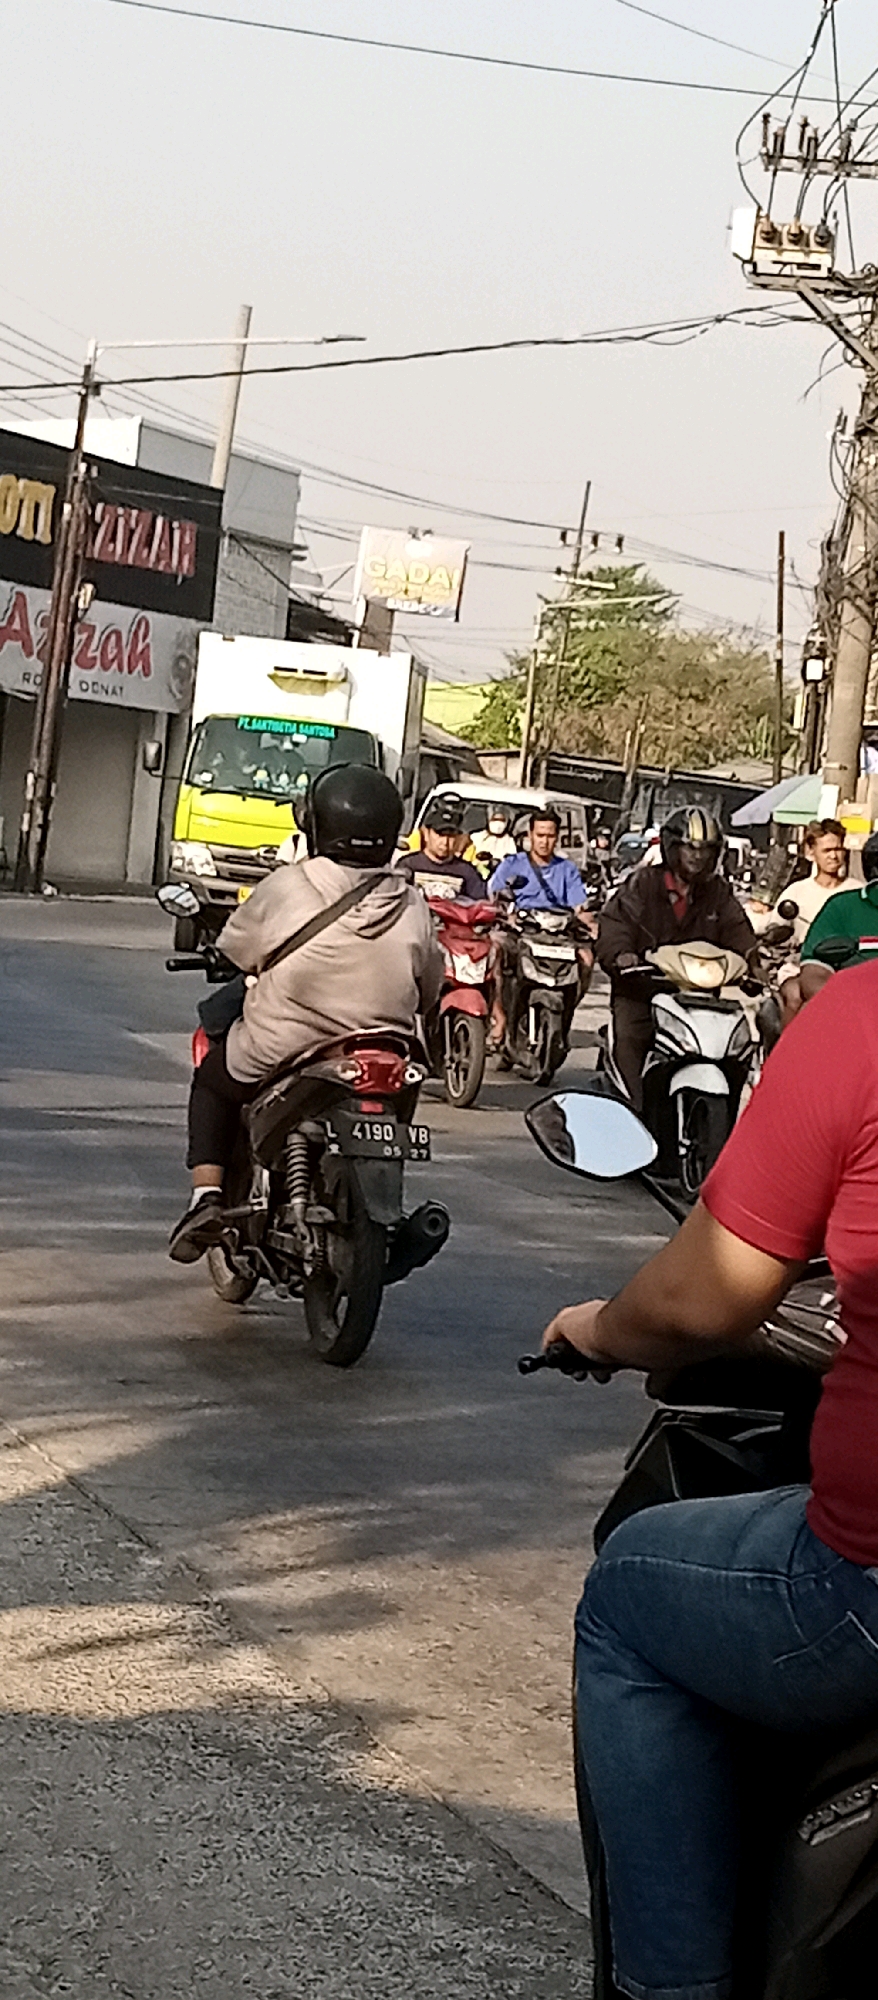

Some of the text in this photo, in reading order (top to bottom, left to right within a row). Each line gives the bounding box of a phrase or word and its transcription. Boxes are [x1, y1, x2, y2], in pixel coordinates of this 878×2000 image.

[85, 502, 196, 577] ZIZAH
[364, 556, 461, 590] GADAI
[326, 1121, 429, 1144] L 4190 VB
